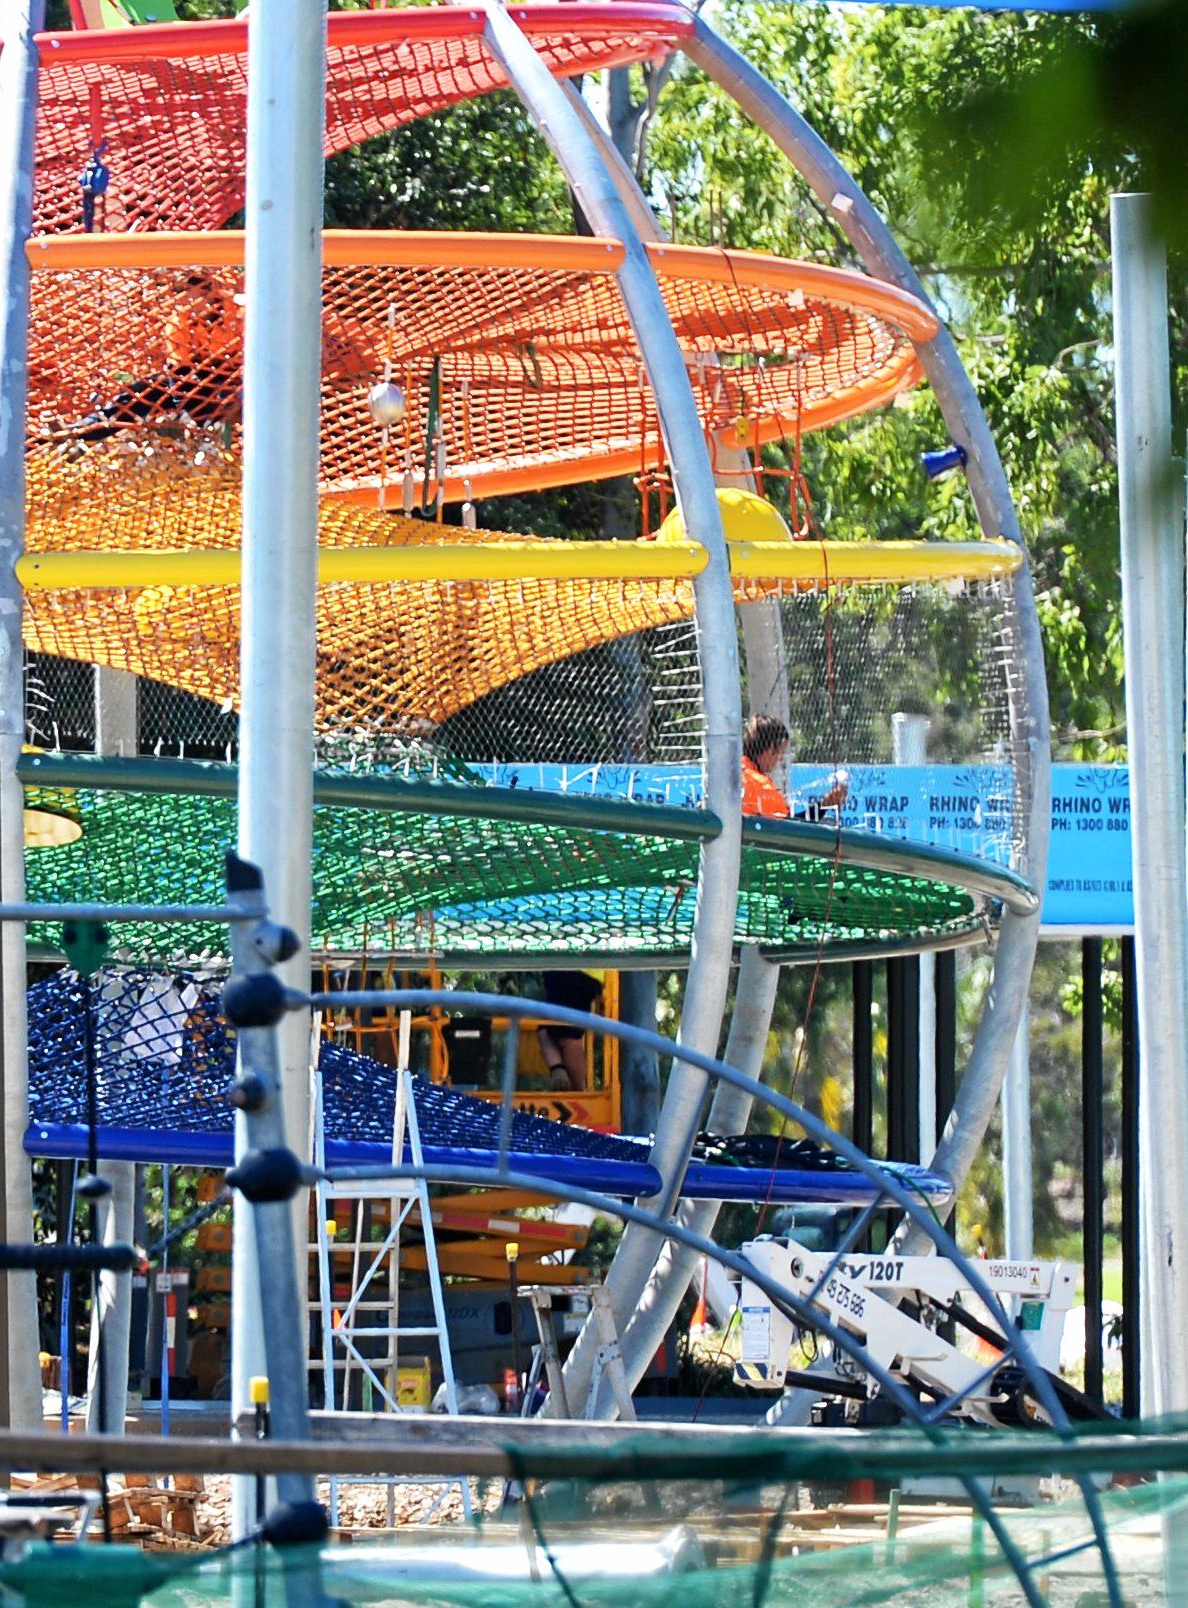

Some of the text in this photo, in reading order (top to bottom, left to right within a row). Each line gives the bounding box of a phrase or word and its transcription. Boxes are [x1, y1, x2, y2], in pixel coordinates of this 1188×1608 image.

[864, 796, 909, 812] WRAP
[929, 796, 980, 812] RHINO
[1052, 797, 1102, 813] RHINO
[1051, 817, 1128, 831] PH: 1300 880
[869, 1261, 904, 1281] 120T
